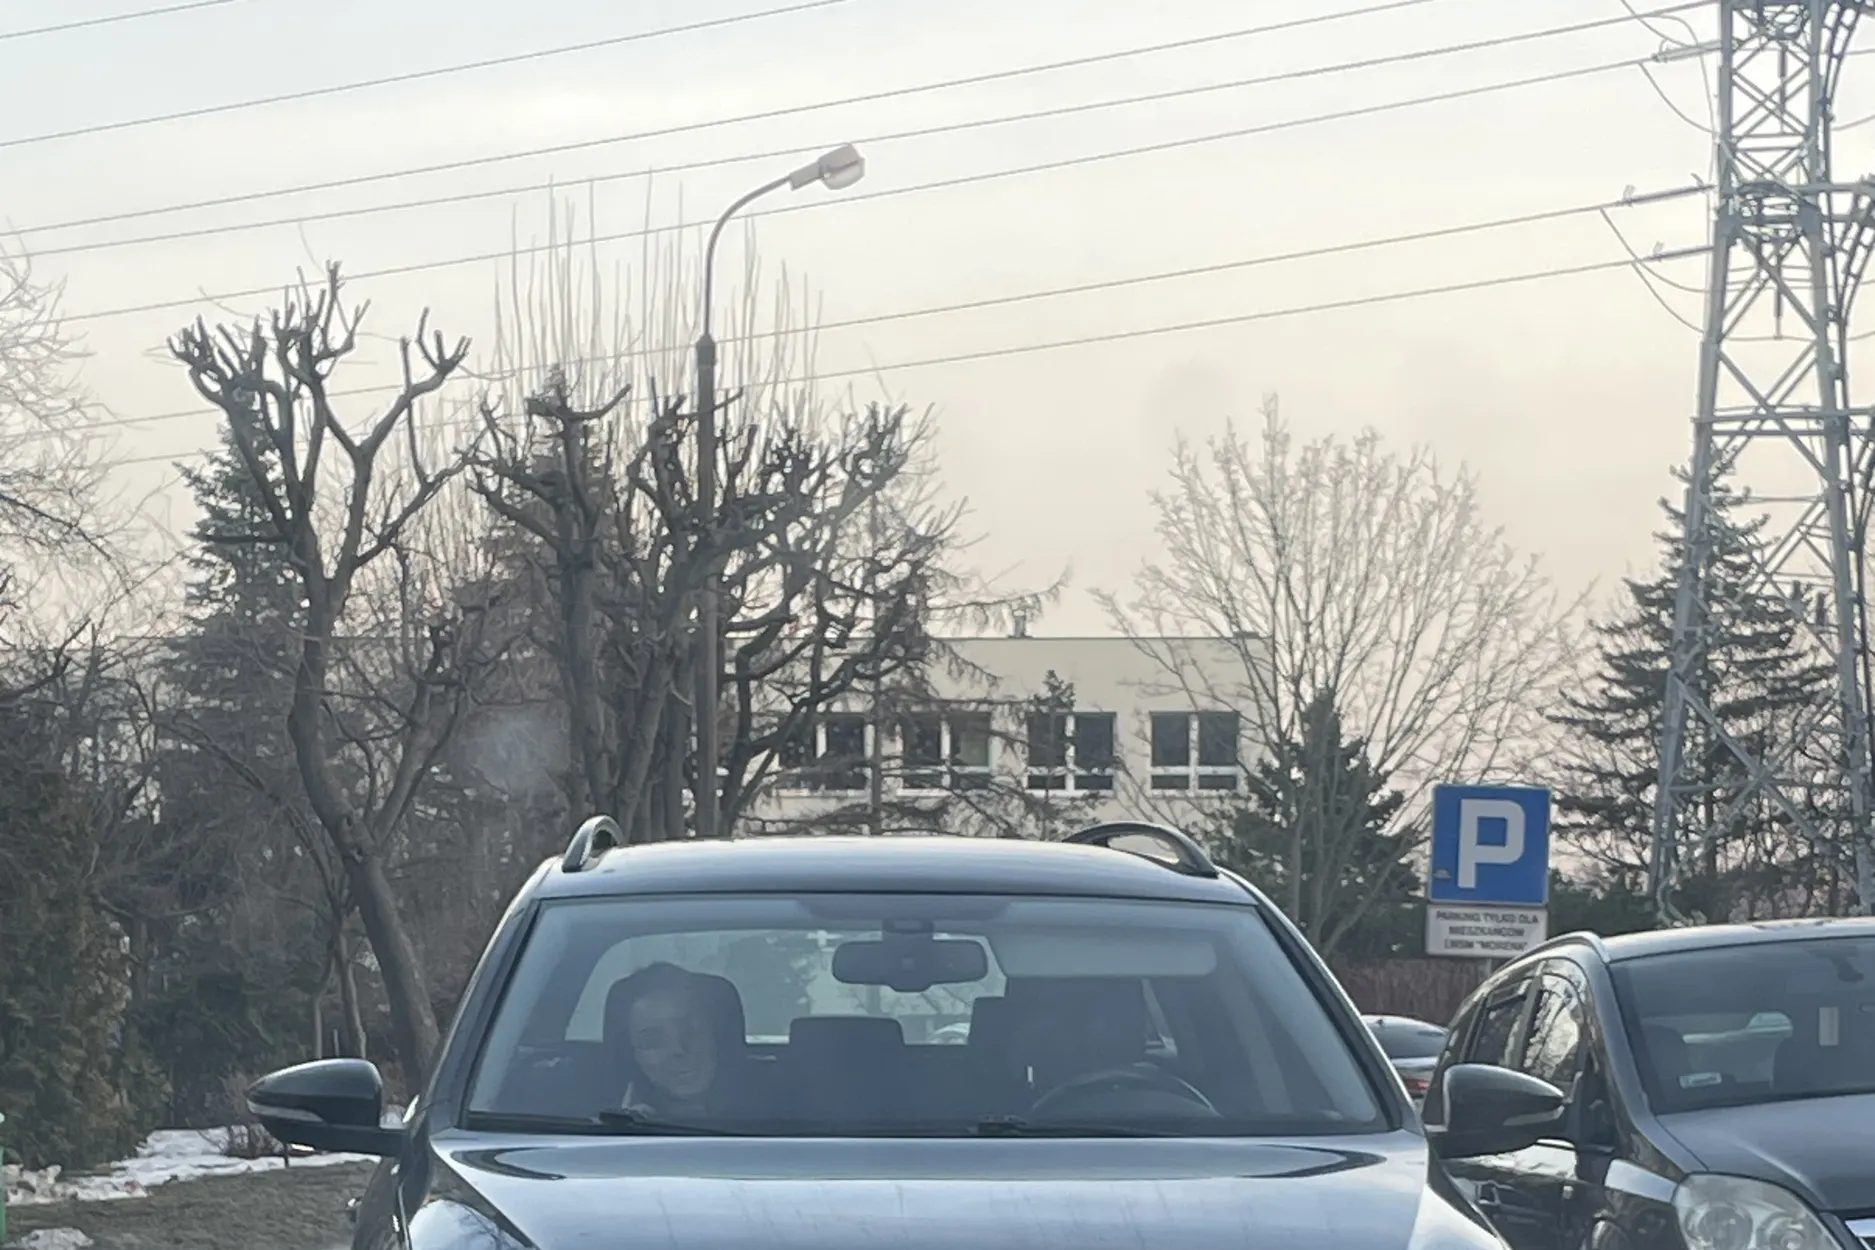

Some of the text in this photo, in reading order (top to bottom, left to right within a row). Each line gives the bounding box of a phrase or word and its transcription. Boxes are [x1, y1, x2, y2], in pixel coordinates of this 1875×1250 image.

[1458, 798, 1525, 888] P
[1436, 910, 1539, 924] PARKING TYLKO DLA
